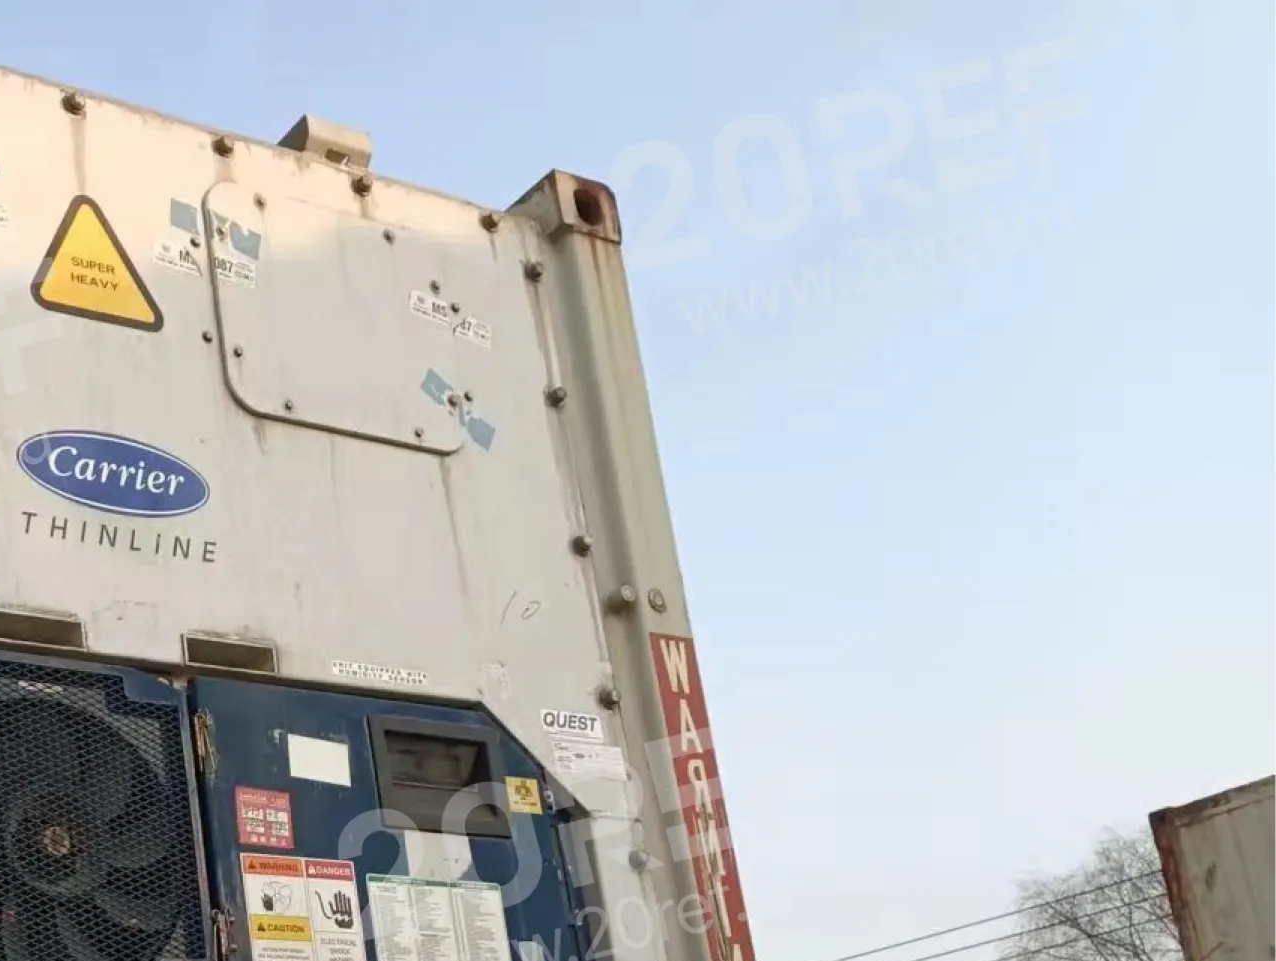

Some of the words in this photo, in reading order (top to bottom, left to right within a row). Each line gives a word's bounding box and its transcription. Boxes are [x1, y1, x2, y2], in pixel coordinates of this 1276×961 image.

[71, 256, 115, 275] SUPER
[70, 271, 118, 291] HEAVY
[47, 444, 185, 496] Carrier
[543, 711, 598, 732] QUEST
[259, 862, 299, 873] WARNING
[316, 865, 352, 876] DANGER
[267, 923, 306, 934] CAUTION
